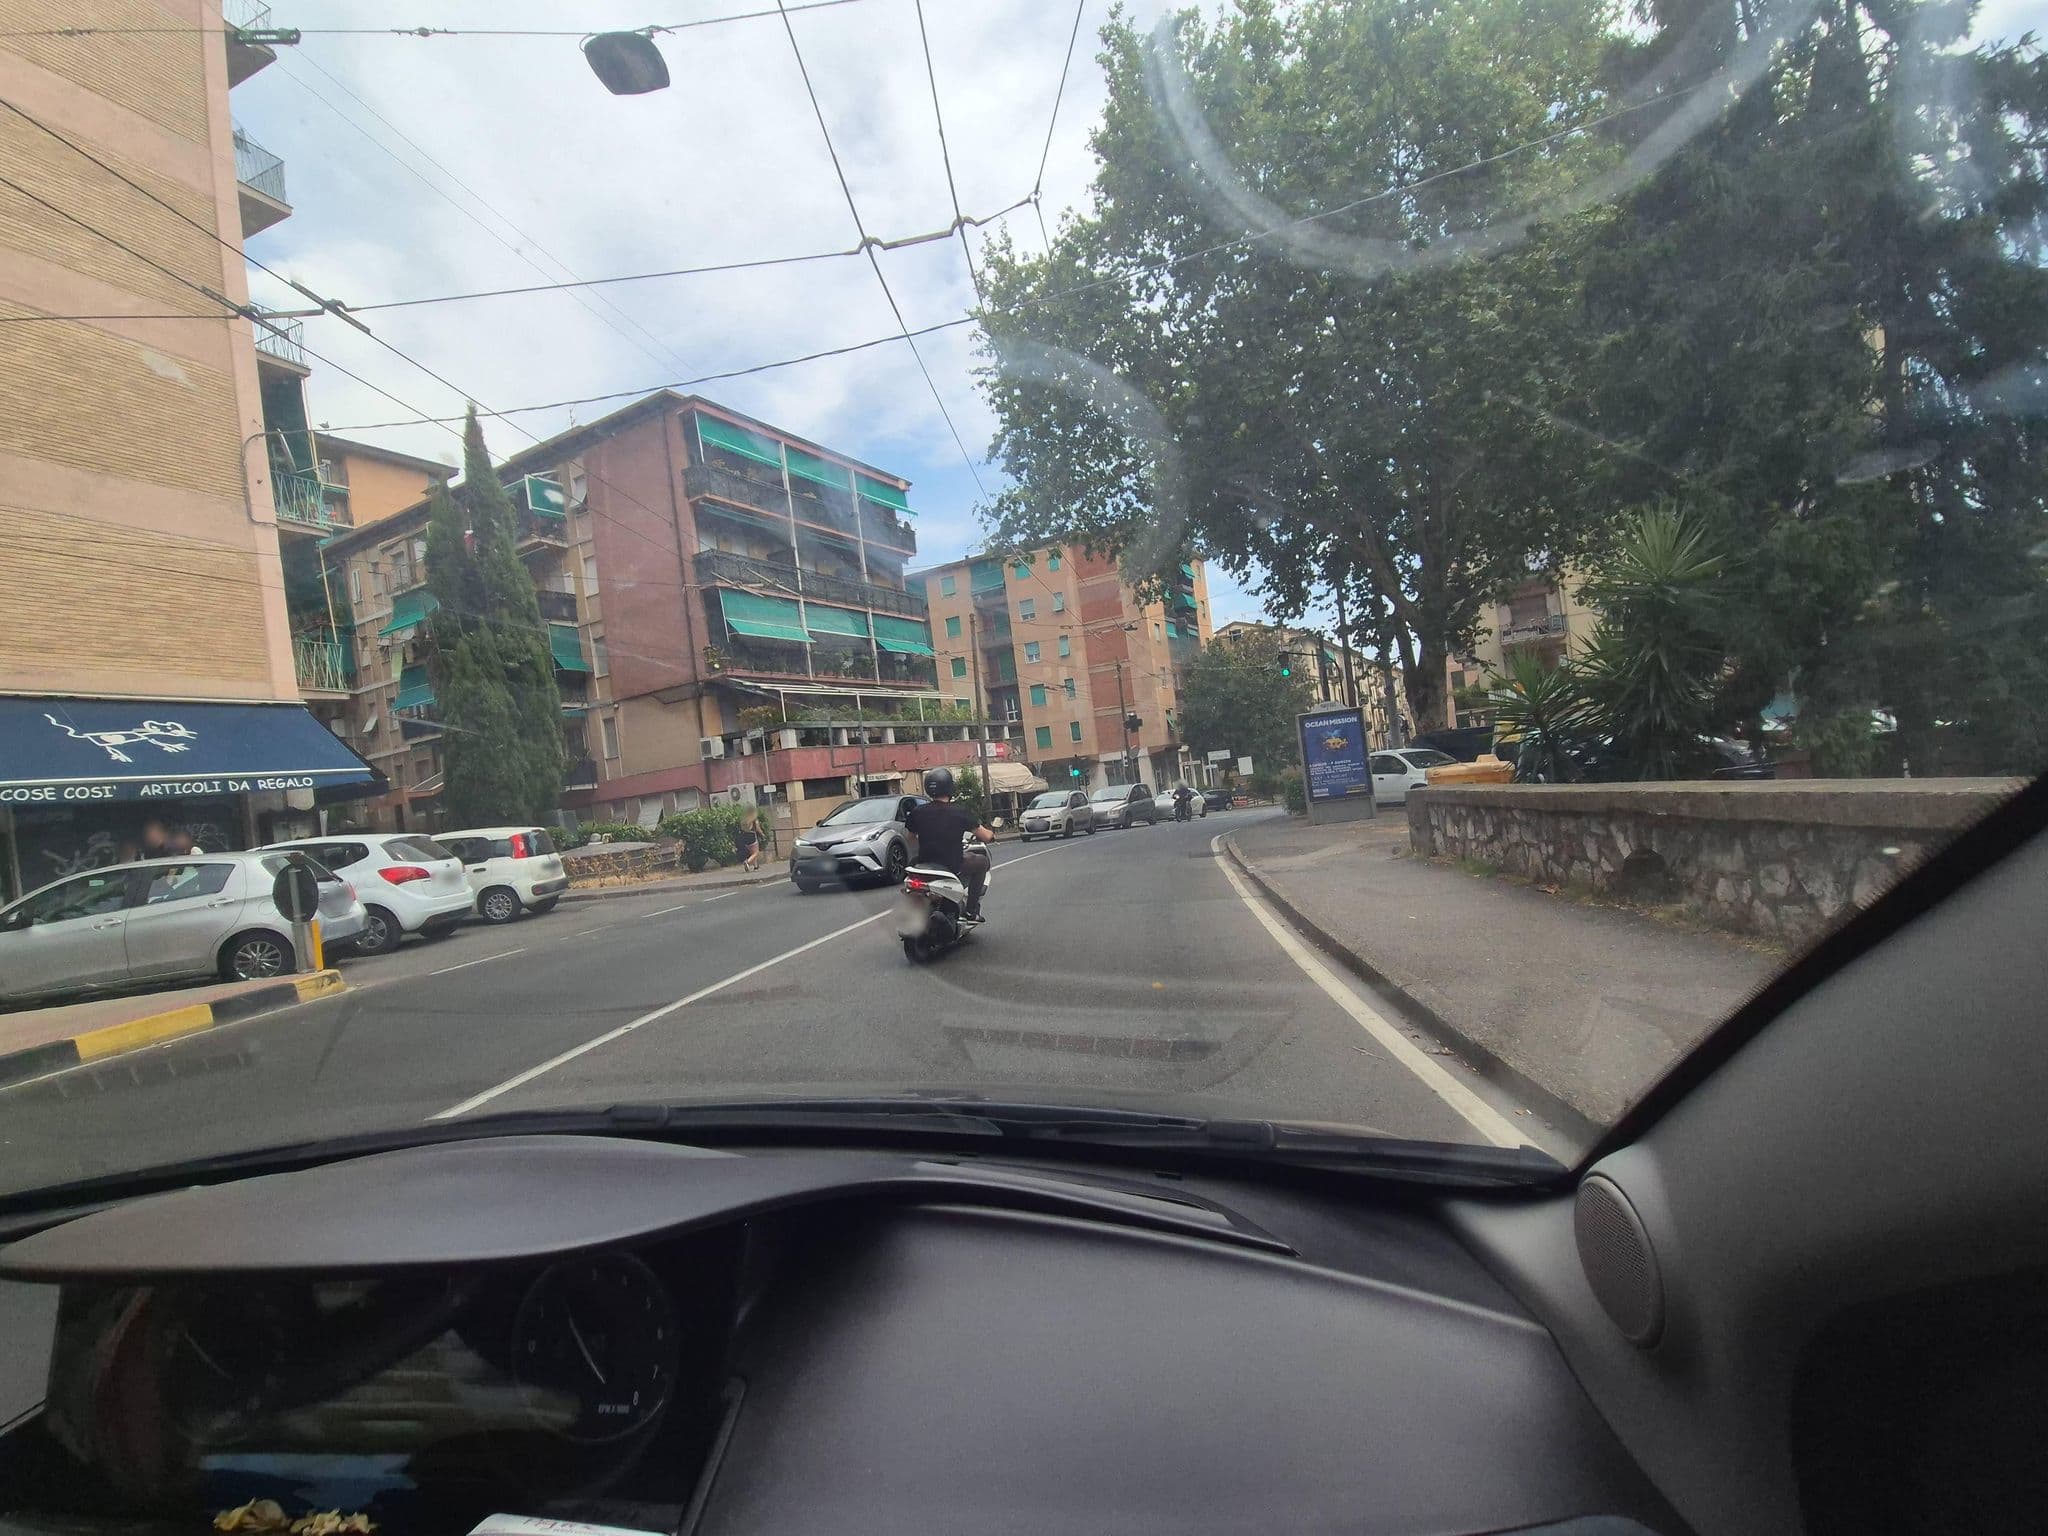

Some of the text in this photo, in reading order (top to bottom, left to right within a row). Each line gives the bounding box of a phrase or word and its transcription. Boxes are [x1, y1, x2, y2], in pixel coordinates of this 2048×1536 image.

[1305, 717, 1357, 728] OCEAN MISSION
[0, 777, 314, 801] COSE COSI' ARTICOLI DA REGALO
[632, 1390, 640, 1406] 8
